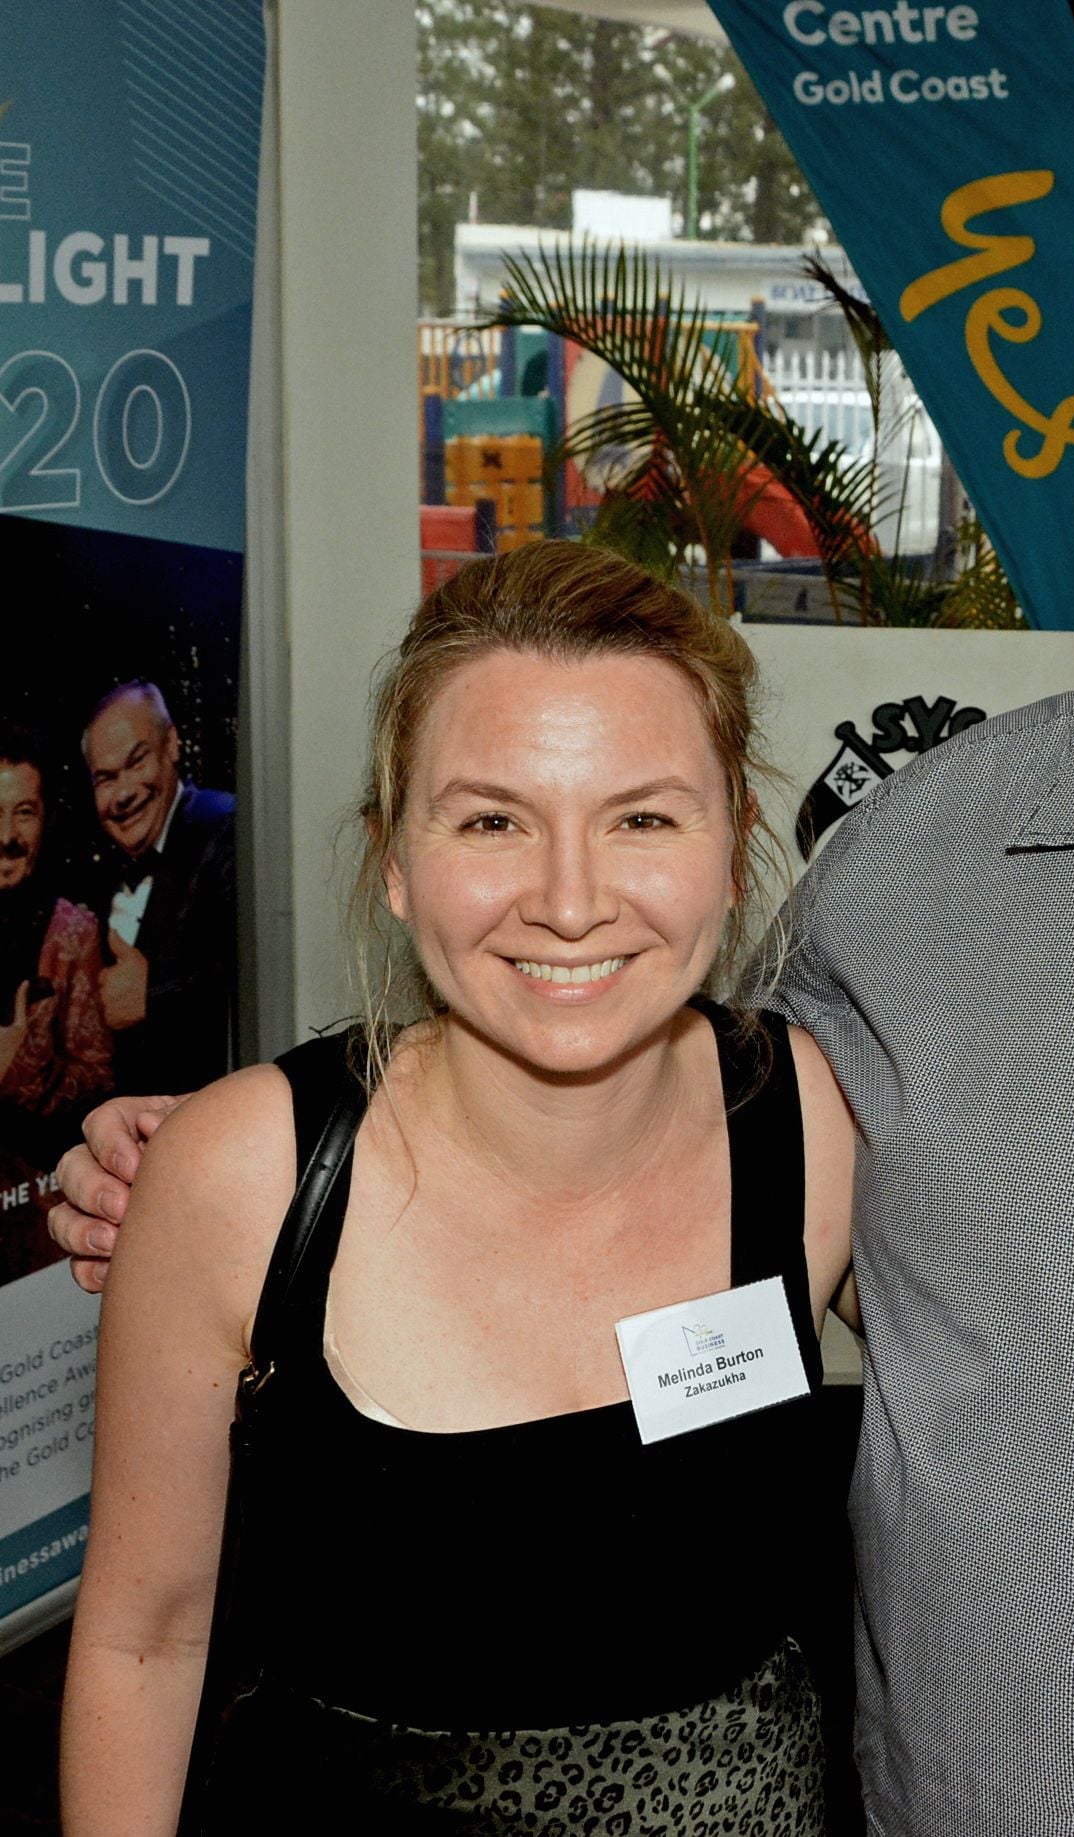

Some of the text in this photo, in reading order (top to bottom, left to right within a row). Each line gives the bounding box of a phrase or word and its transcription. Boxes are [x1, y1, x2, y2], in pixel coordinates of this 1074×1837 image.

[783, 0, 980, 46] Centre
[793, 66, 1009, 106] Gold Coast
[0, 1182, 30, 1211] HE
[657, 1363, 713, 1388] Melinda
[715, 1348, 764, 1371] Burton
[684, 1370, 746, 1398] Zakazukha
[27, 1431, 69, 1466] Gold
